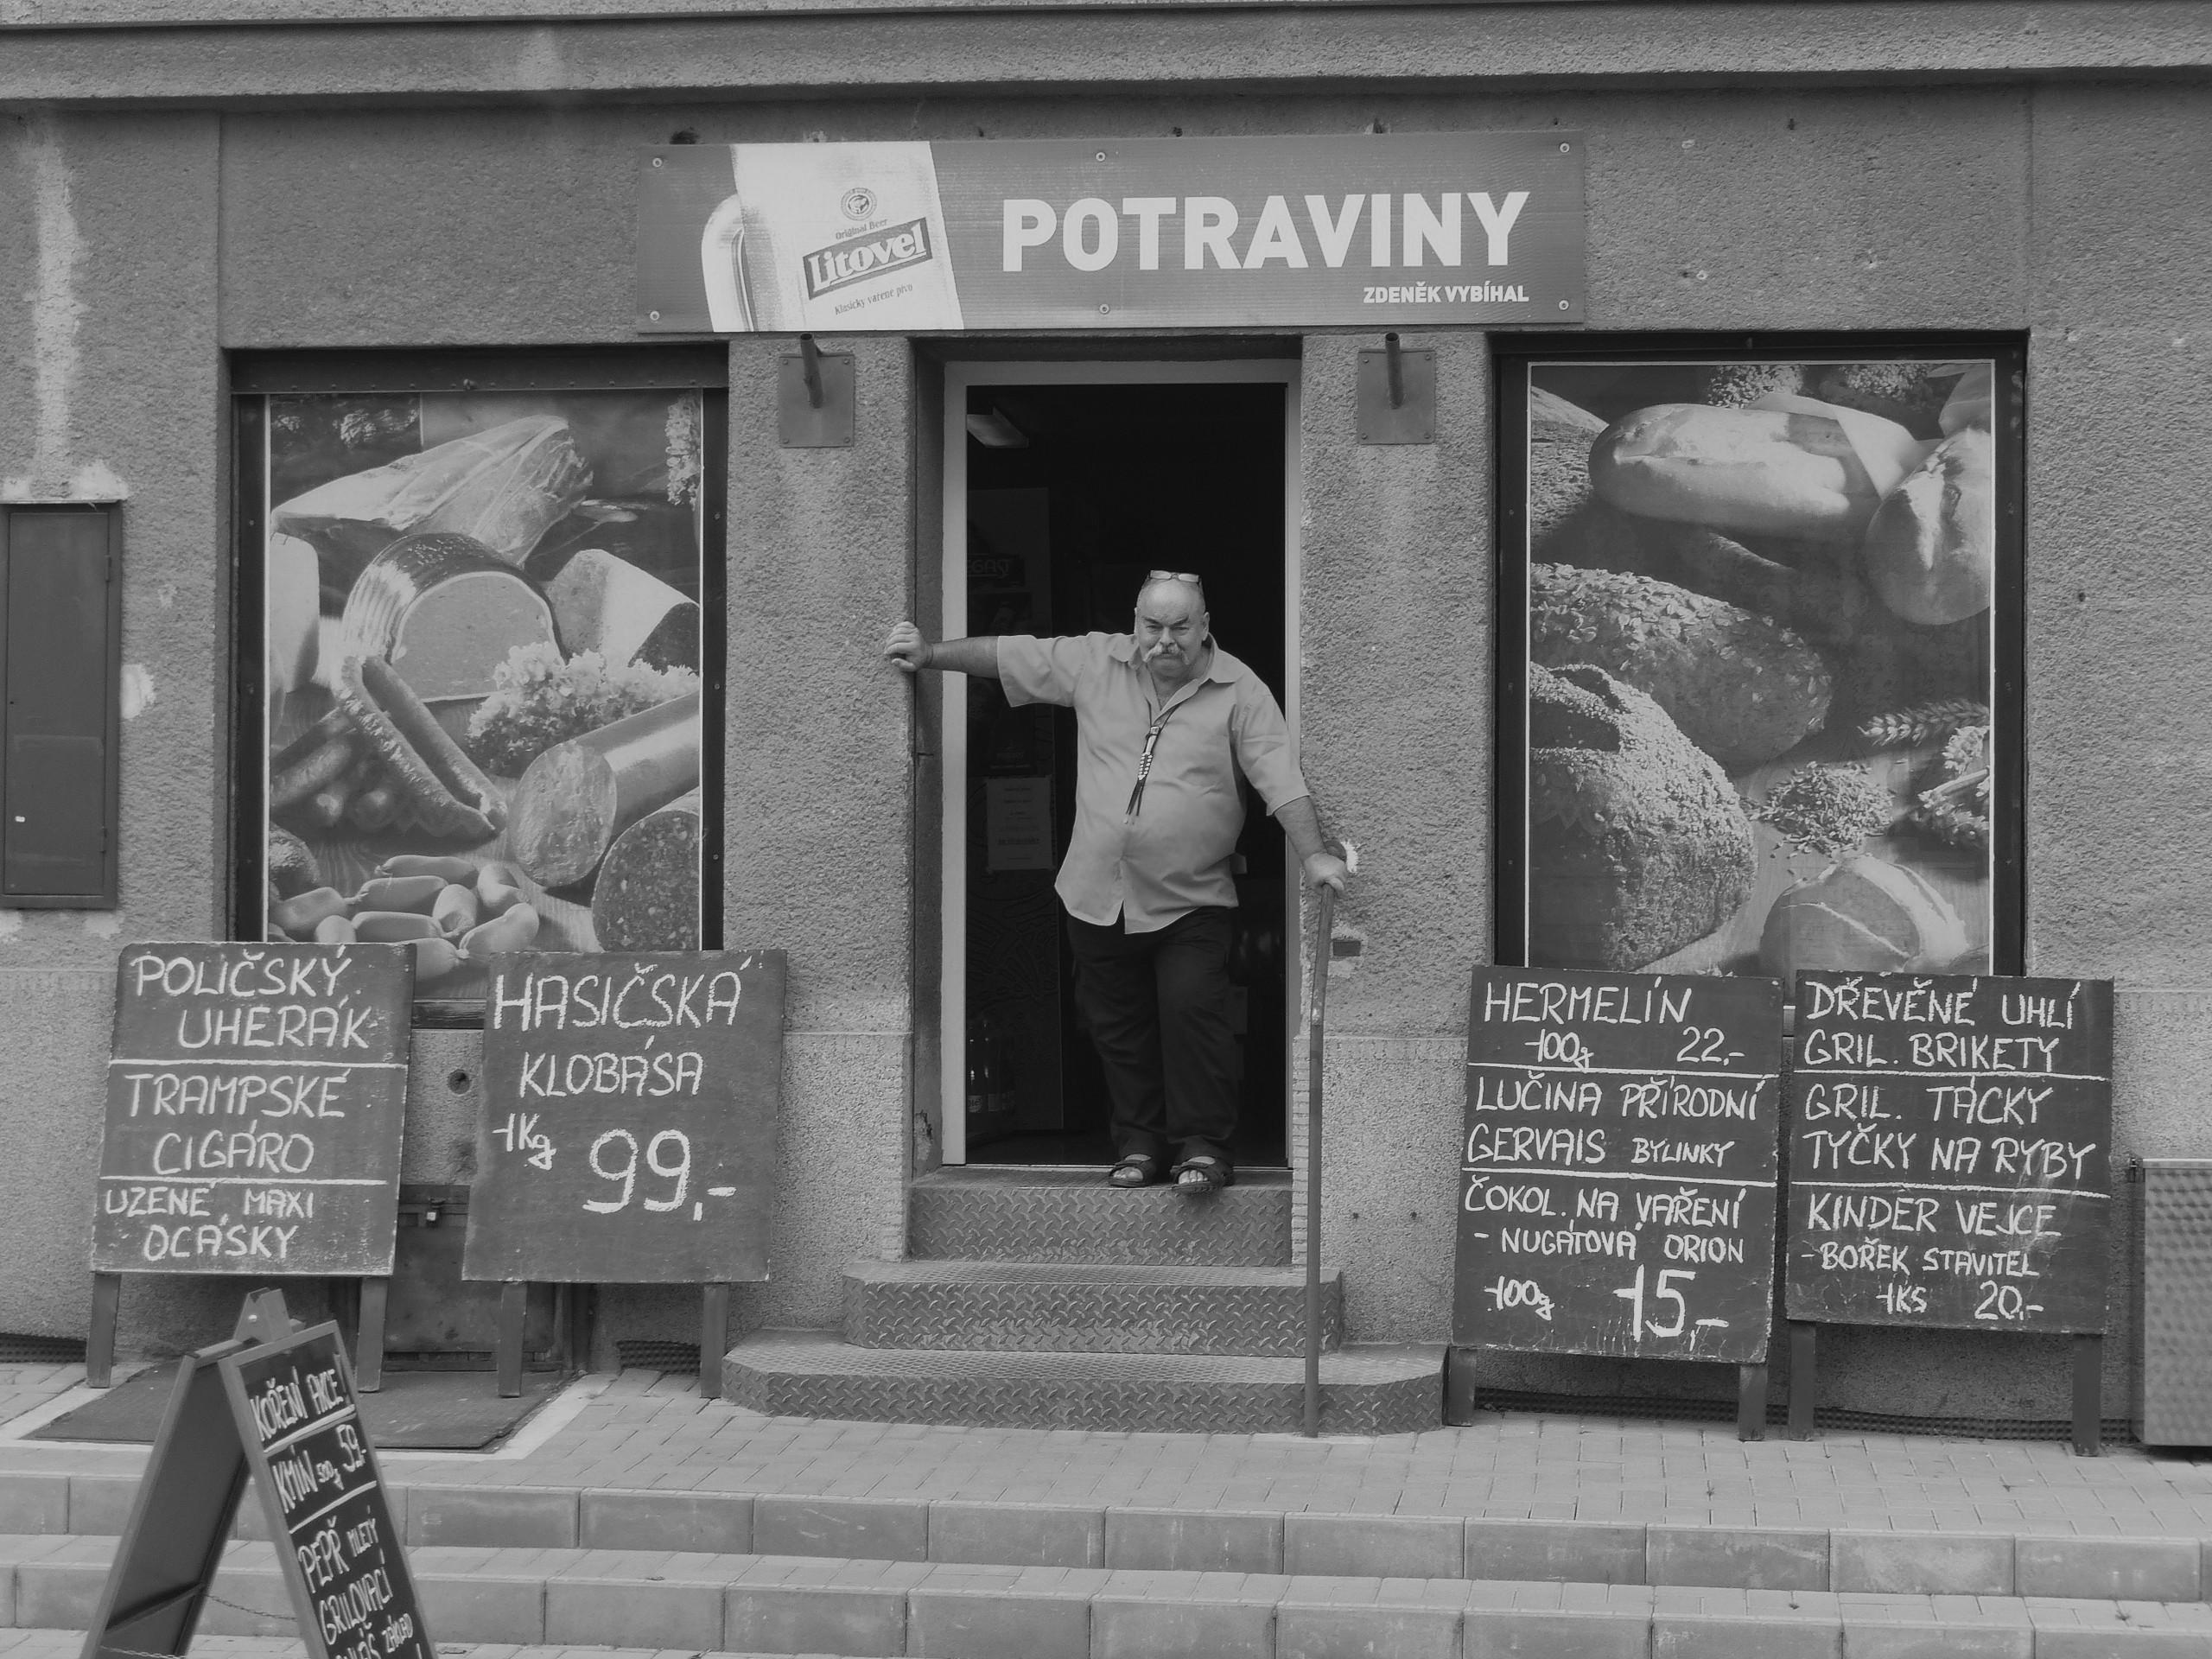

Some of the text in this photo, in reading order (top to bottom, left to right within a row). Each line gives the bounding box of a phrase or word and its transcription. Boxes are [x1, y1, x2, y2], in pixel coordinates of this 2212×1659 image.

[809, 221, 927, 292] Litovel
[1003, 191, 1530, 271] POTRAVINY
[1363, 280, 1529, 303] ZDENĚK VYBÍHAL
[130, 944, 352, 996] POLIČSKÝ
[493, 956, 752, 1032] HASIČSKÁ
[178, 995, 372, 1049] UHERÁK
[1484, 976, 1692, 1025] HERMELÍN
[1805, 976, 2081, 1029] DŘEVĚNÉ UHLÍ
[520, 1035, 703, 1097] KLOBÁSA
[1524, 1029, 1594, 1069] 100g
[1804, 1029, 2060, 1072] GRIL. BRIKETY
[124, 1068, 351, 1117] TRAMPSKÉ
[1475, 1071, 1766, 1120] LUČINA PŘÍRODNÍ
[1804, 1075, 2054, 1125] GRIL. TÁCKY
[154, 1119, 314, 1174] CIGÁRO
[1468, 1122, 1735, 1168] GERVAIS BYLINKY
[1802, 1122, 2096, 1179] TYČKY NA RYBY
[105, 1181, 313, 1218] UZENÉ MAXI
[582, 1128, 736, 1221] 99,-
[1465, 1175, 1747, 1229] ČOKOL. NA VAŘENÍ
[1808, 1192, 2062, 1236] KINDER VEJCE
[143, 1214, 299, 1262] OCÁSKY
[1663, 1234, 1744, 1263] ORION
[1922, 1247, 2040, 1277] STAVITEL
[1484, 1275, 1555, 1321] 100g
[250, 1365, 308, 1442] KOŘENÍ
[272, 1444, 319, 1514] KMÍN
[298, 1504, 378, 1593] PEPŘ MLETÝ
[320, 1548, 393, 1645] GRILOVACÍ
